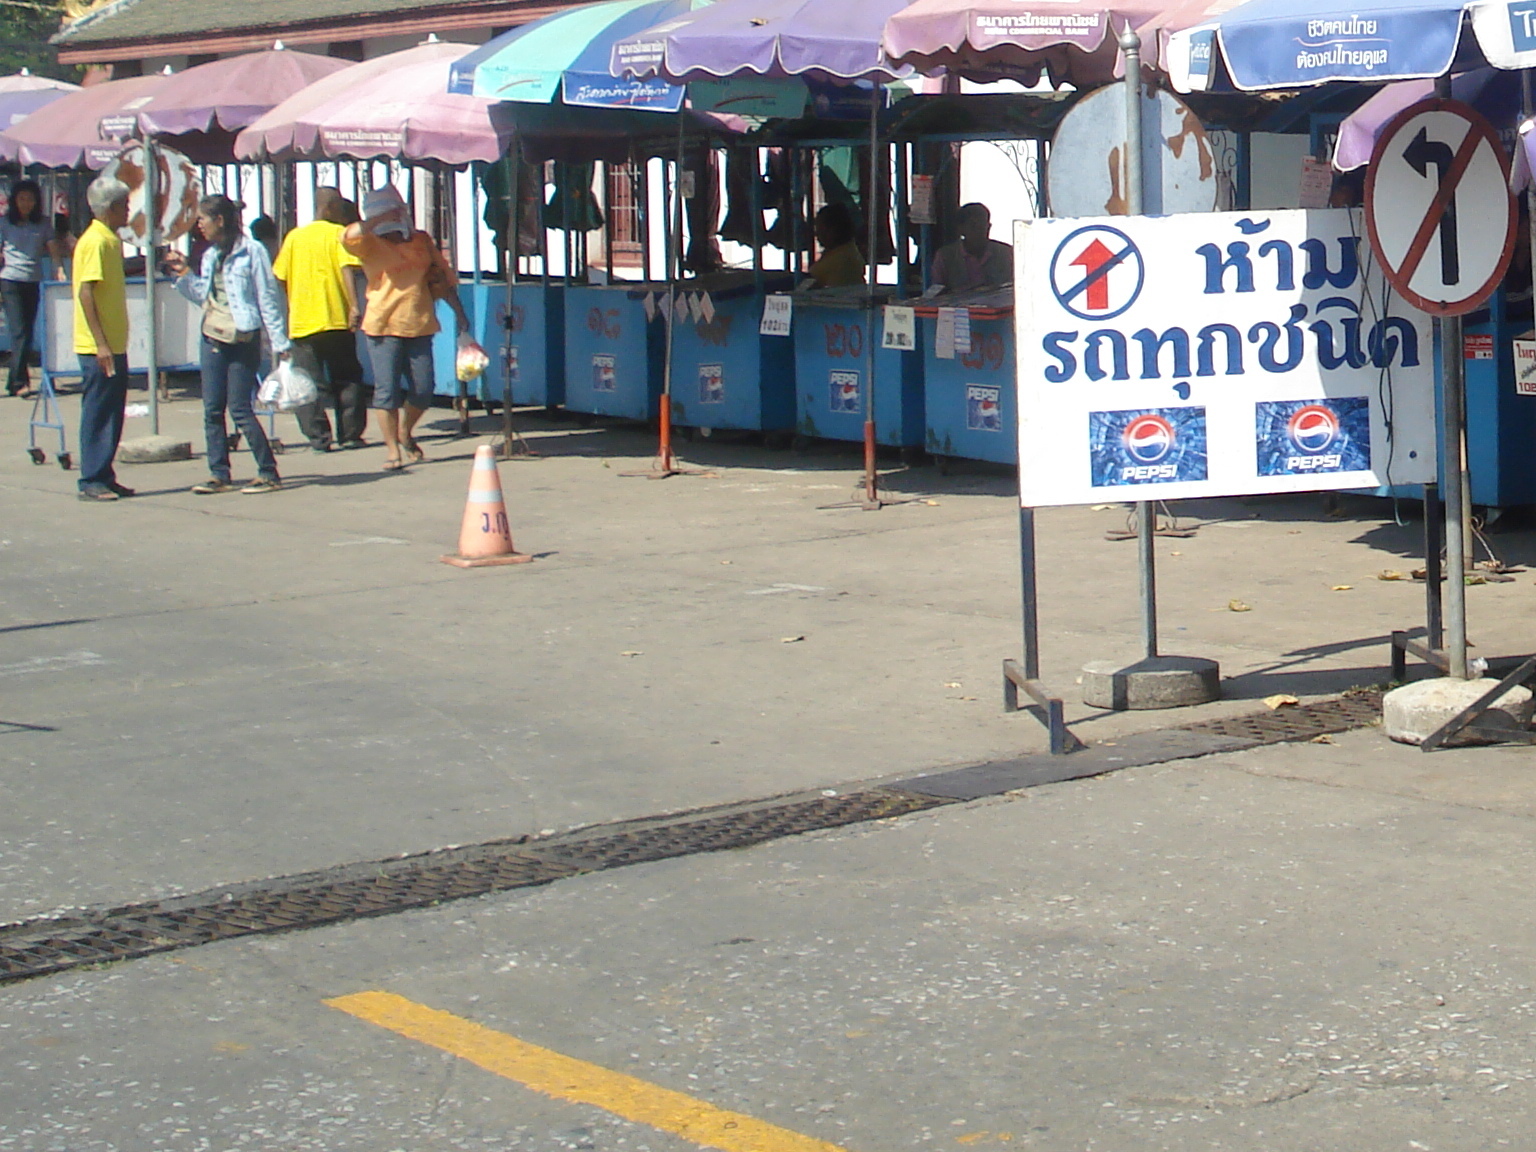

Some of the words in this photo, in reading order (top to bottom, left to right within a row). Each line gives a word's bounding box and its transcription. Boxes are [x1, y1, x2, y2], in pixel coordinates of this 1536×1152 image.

[1307, 14, 1377, 38] ชีวิตคนไทย
[1296, 43, 1388, 70] ต้องคนไทยดูแล
[1195, 217, 1362, 294] ห้าม
[1042, 296, 1421, 400] รถทุกชนิด
[830, 373, 858, 386] PEPSI
[967, 388, 999, 402] PEPSI
[1288, 454, 1342, 470] PEPSI
[1122, 464, 1177, 481] PEPSI
